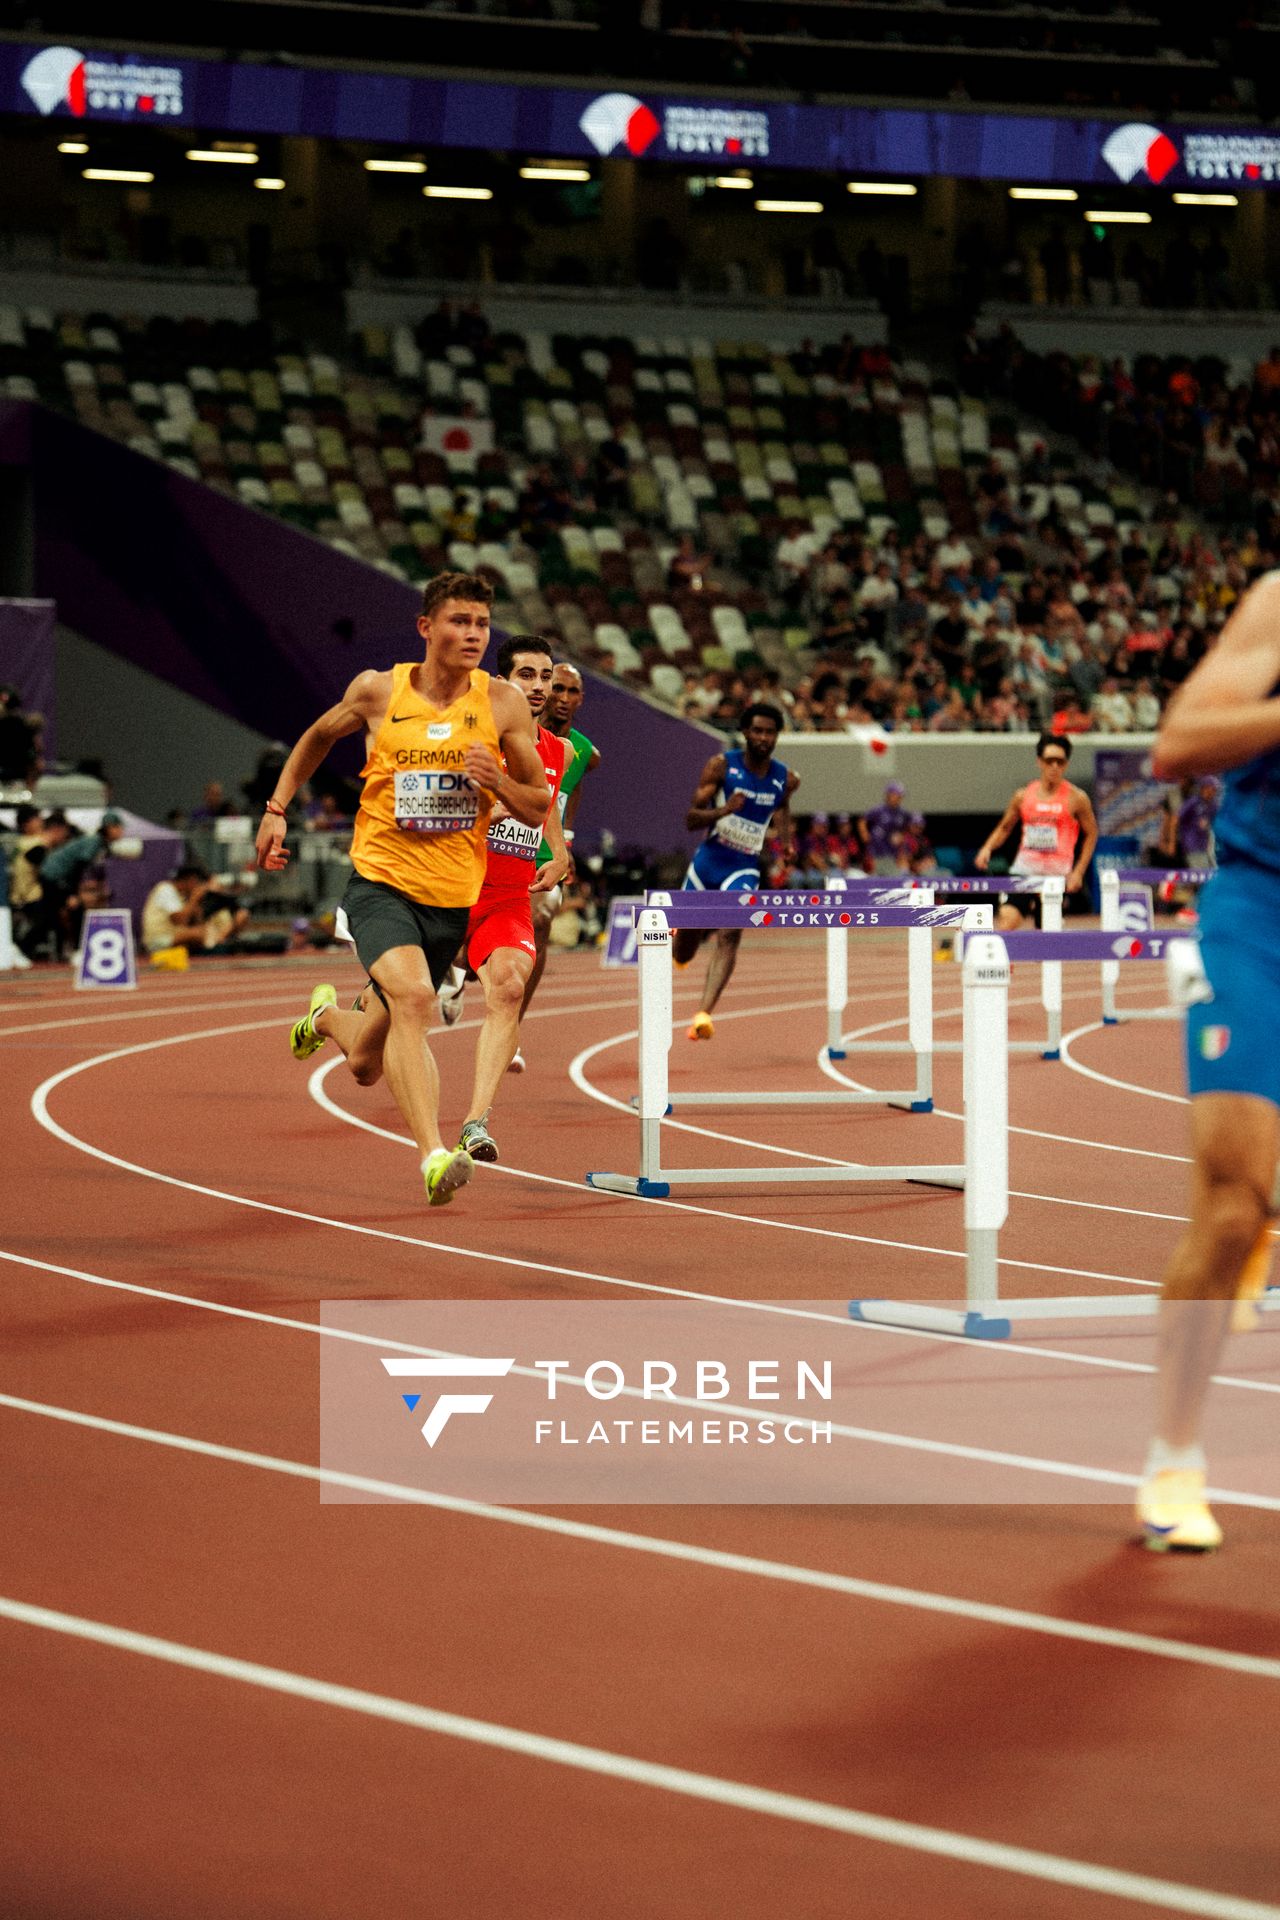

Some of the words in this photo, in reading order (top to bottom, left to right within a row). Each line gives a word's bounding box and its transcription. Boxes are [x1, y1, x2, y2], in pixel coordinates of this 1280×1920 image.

[396, 749, 466, 765] GERMAN
[419, 773, 475, 792] TDK
[399, 796, 478, 815] FISCHER-BREIHOLZ
[488, 823, 540, 847] BRAHIM
[761, 894, 843, 906] TOKYO25
[778, 913, 880, 925] TOKYO25
[643, 932, 668, 941] NISHI
[87, 927, 126, 981] 8
